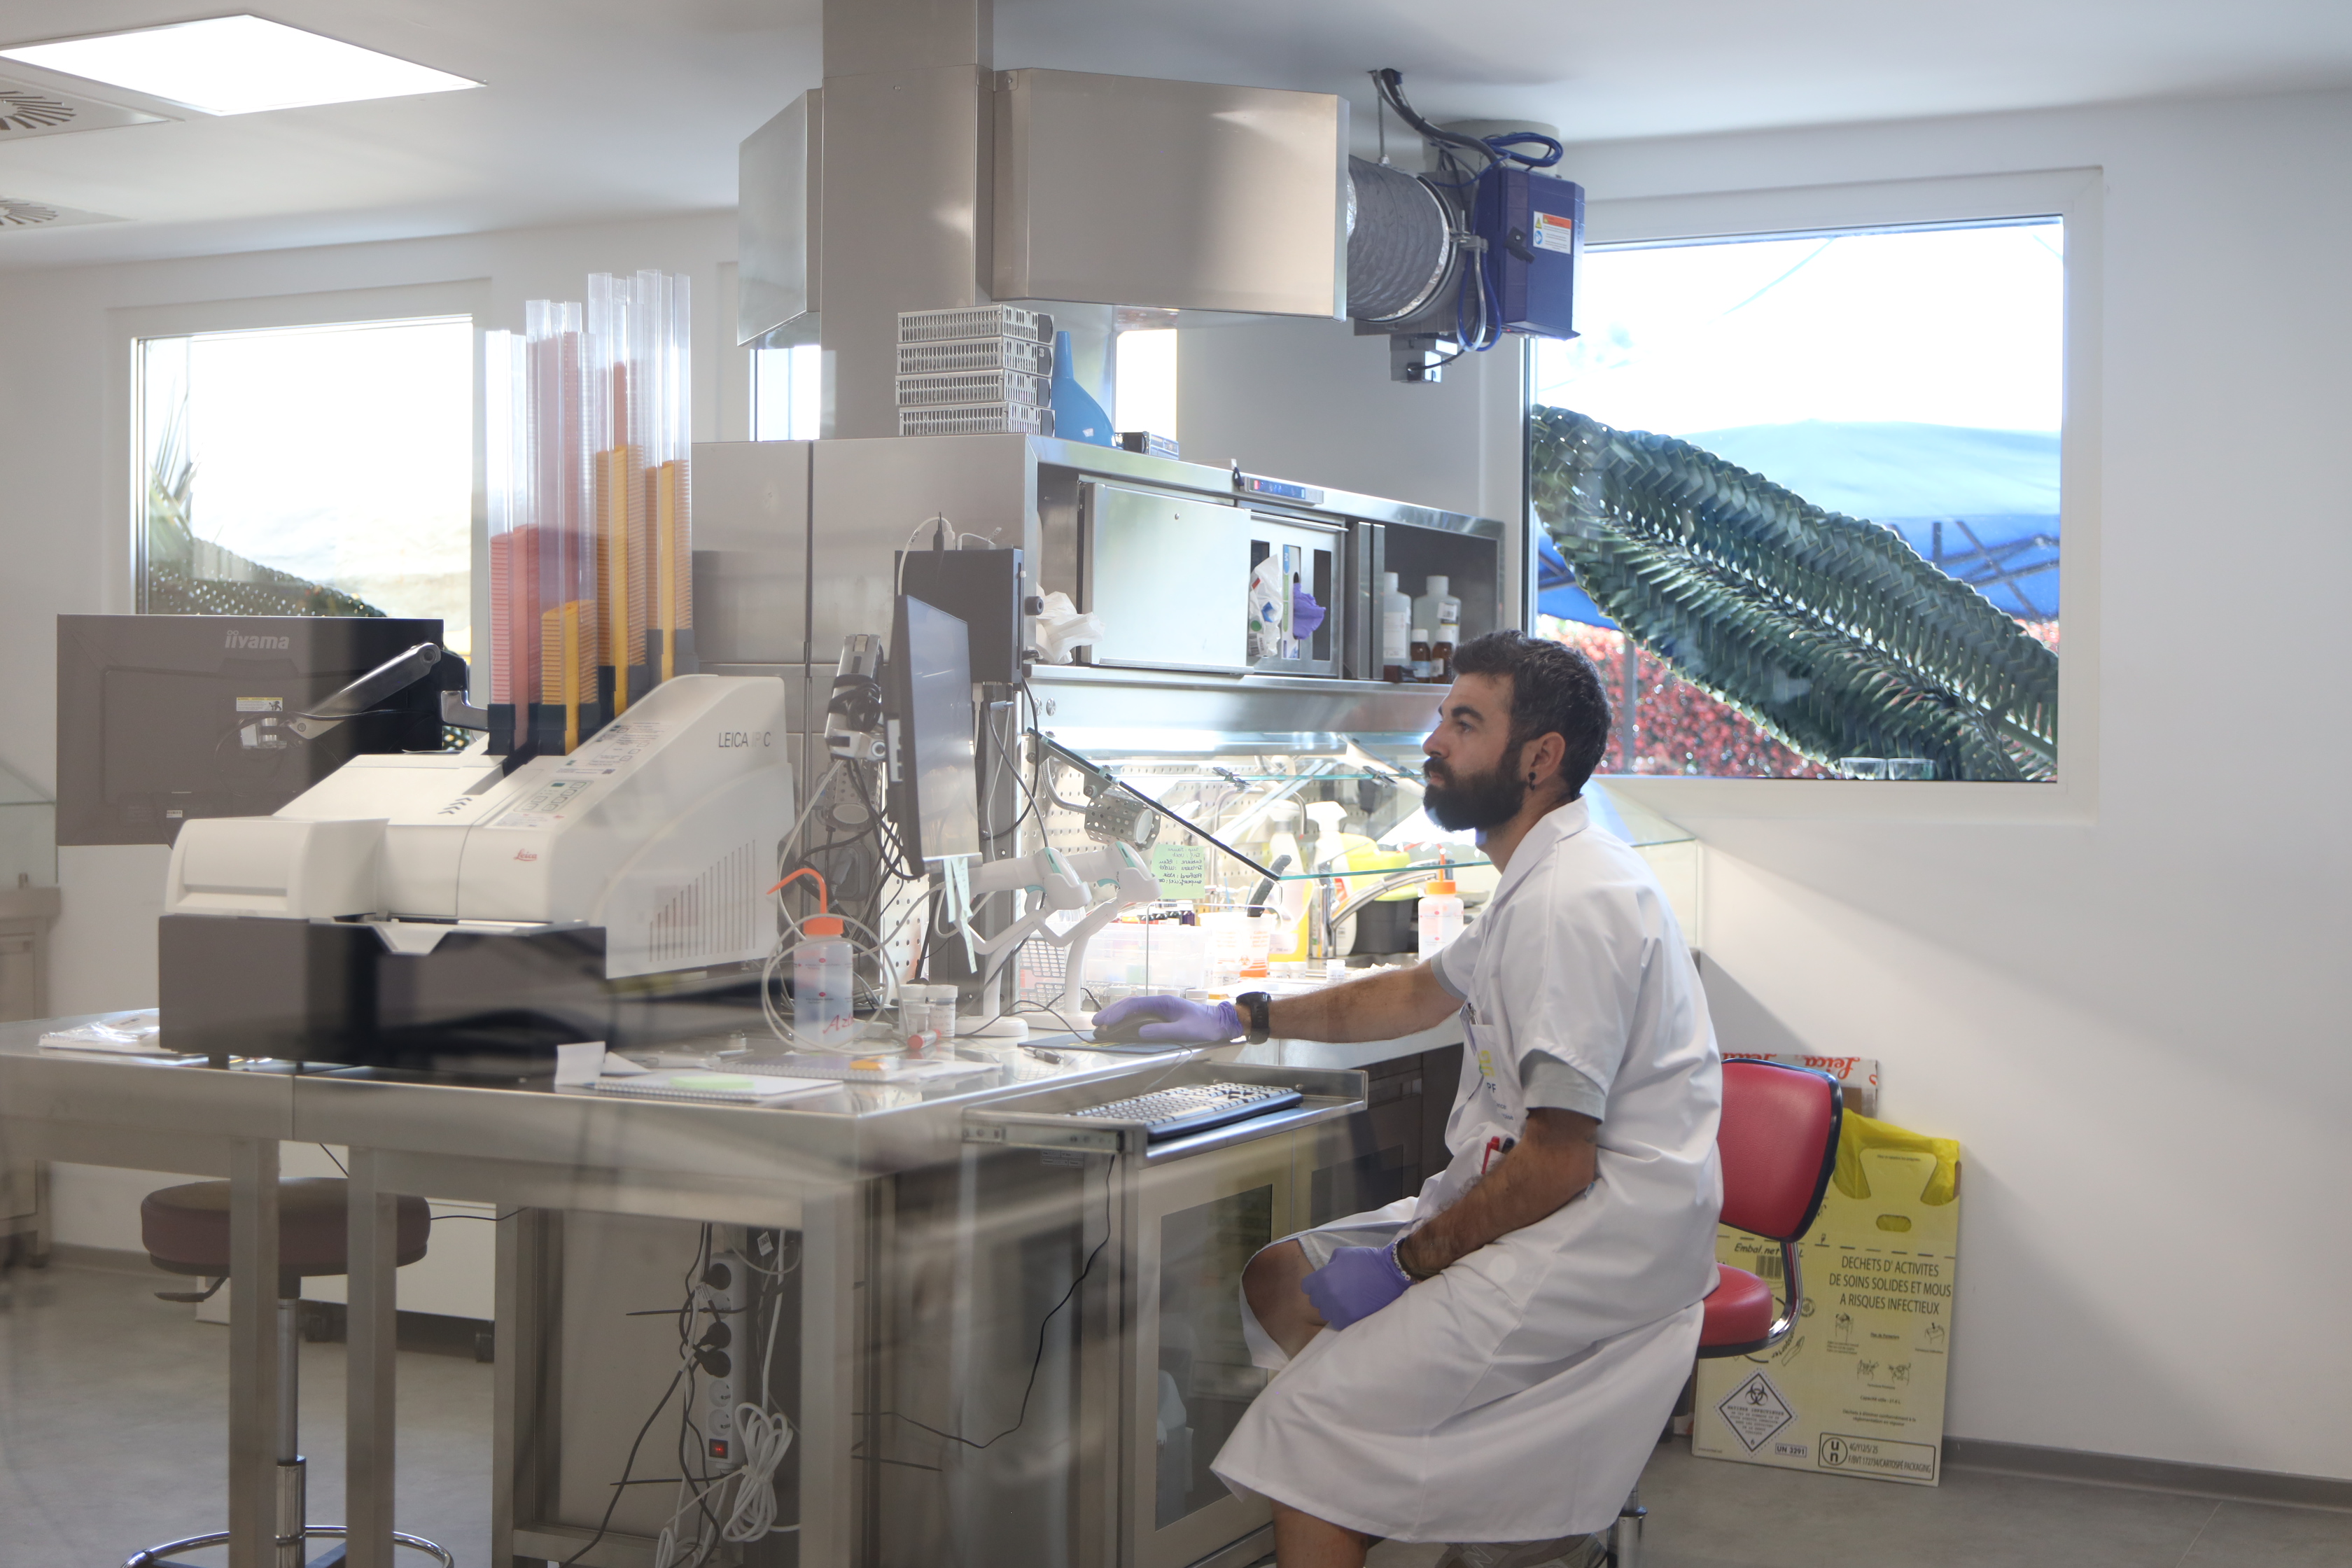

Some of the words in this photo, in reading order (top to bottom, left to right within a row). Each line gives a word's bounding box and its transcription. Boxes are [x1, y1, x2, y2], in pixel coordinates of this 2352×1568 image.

[225, 630, 290, 650] iiyama
[718, 732, 749, 748] LEICA
[764, 732, 771, 747] C
[513, 848, 538, 862] Leica
[1734, 1243, 1780, 1255] Embal.net
[1842, 1255, 1882, 1271] DECHETS
[1895, 1261, 1939, 1278] ACTIVITES
[1829, 1273, 1841, 1286] DE
[1843, 1275, 1870, 1289] SOINS
[1871, 1278, 1909, 1293] SOLIDES
[1910, 1281, 1921, 1294] ET
[1924, 1282, 1952, 1297] MOUS
[1840, 1293, 1847, 1306] A
[1848, 1294, 1886, 1310] RISQUES
[1887, 1298, 1940, 1315] INFECTIEUX
[1790, 1447, 1805, 1455] 3291
[1904, 1462, 1932, 1473] PACKAGING
